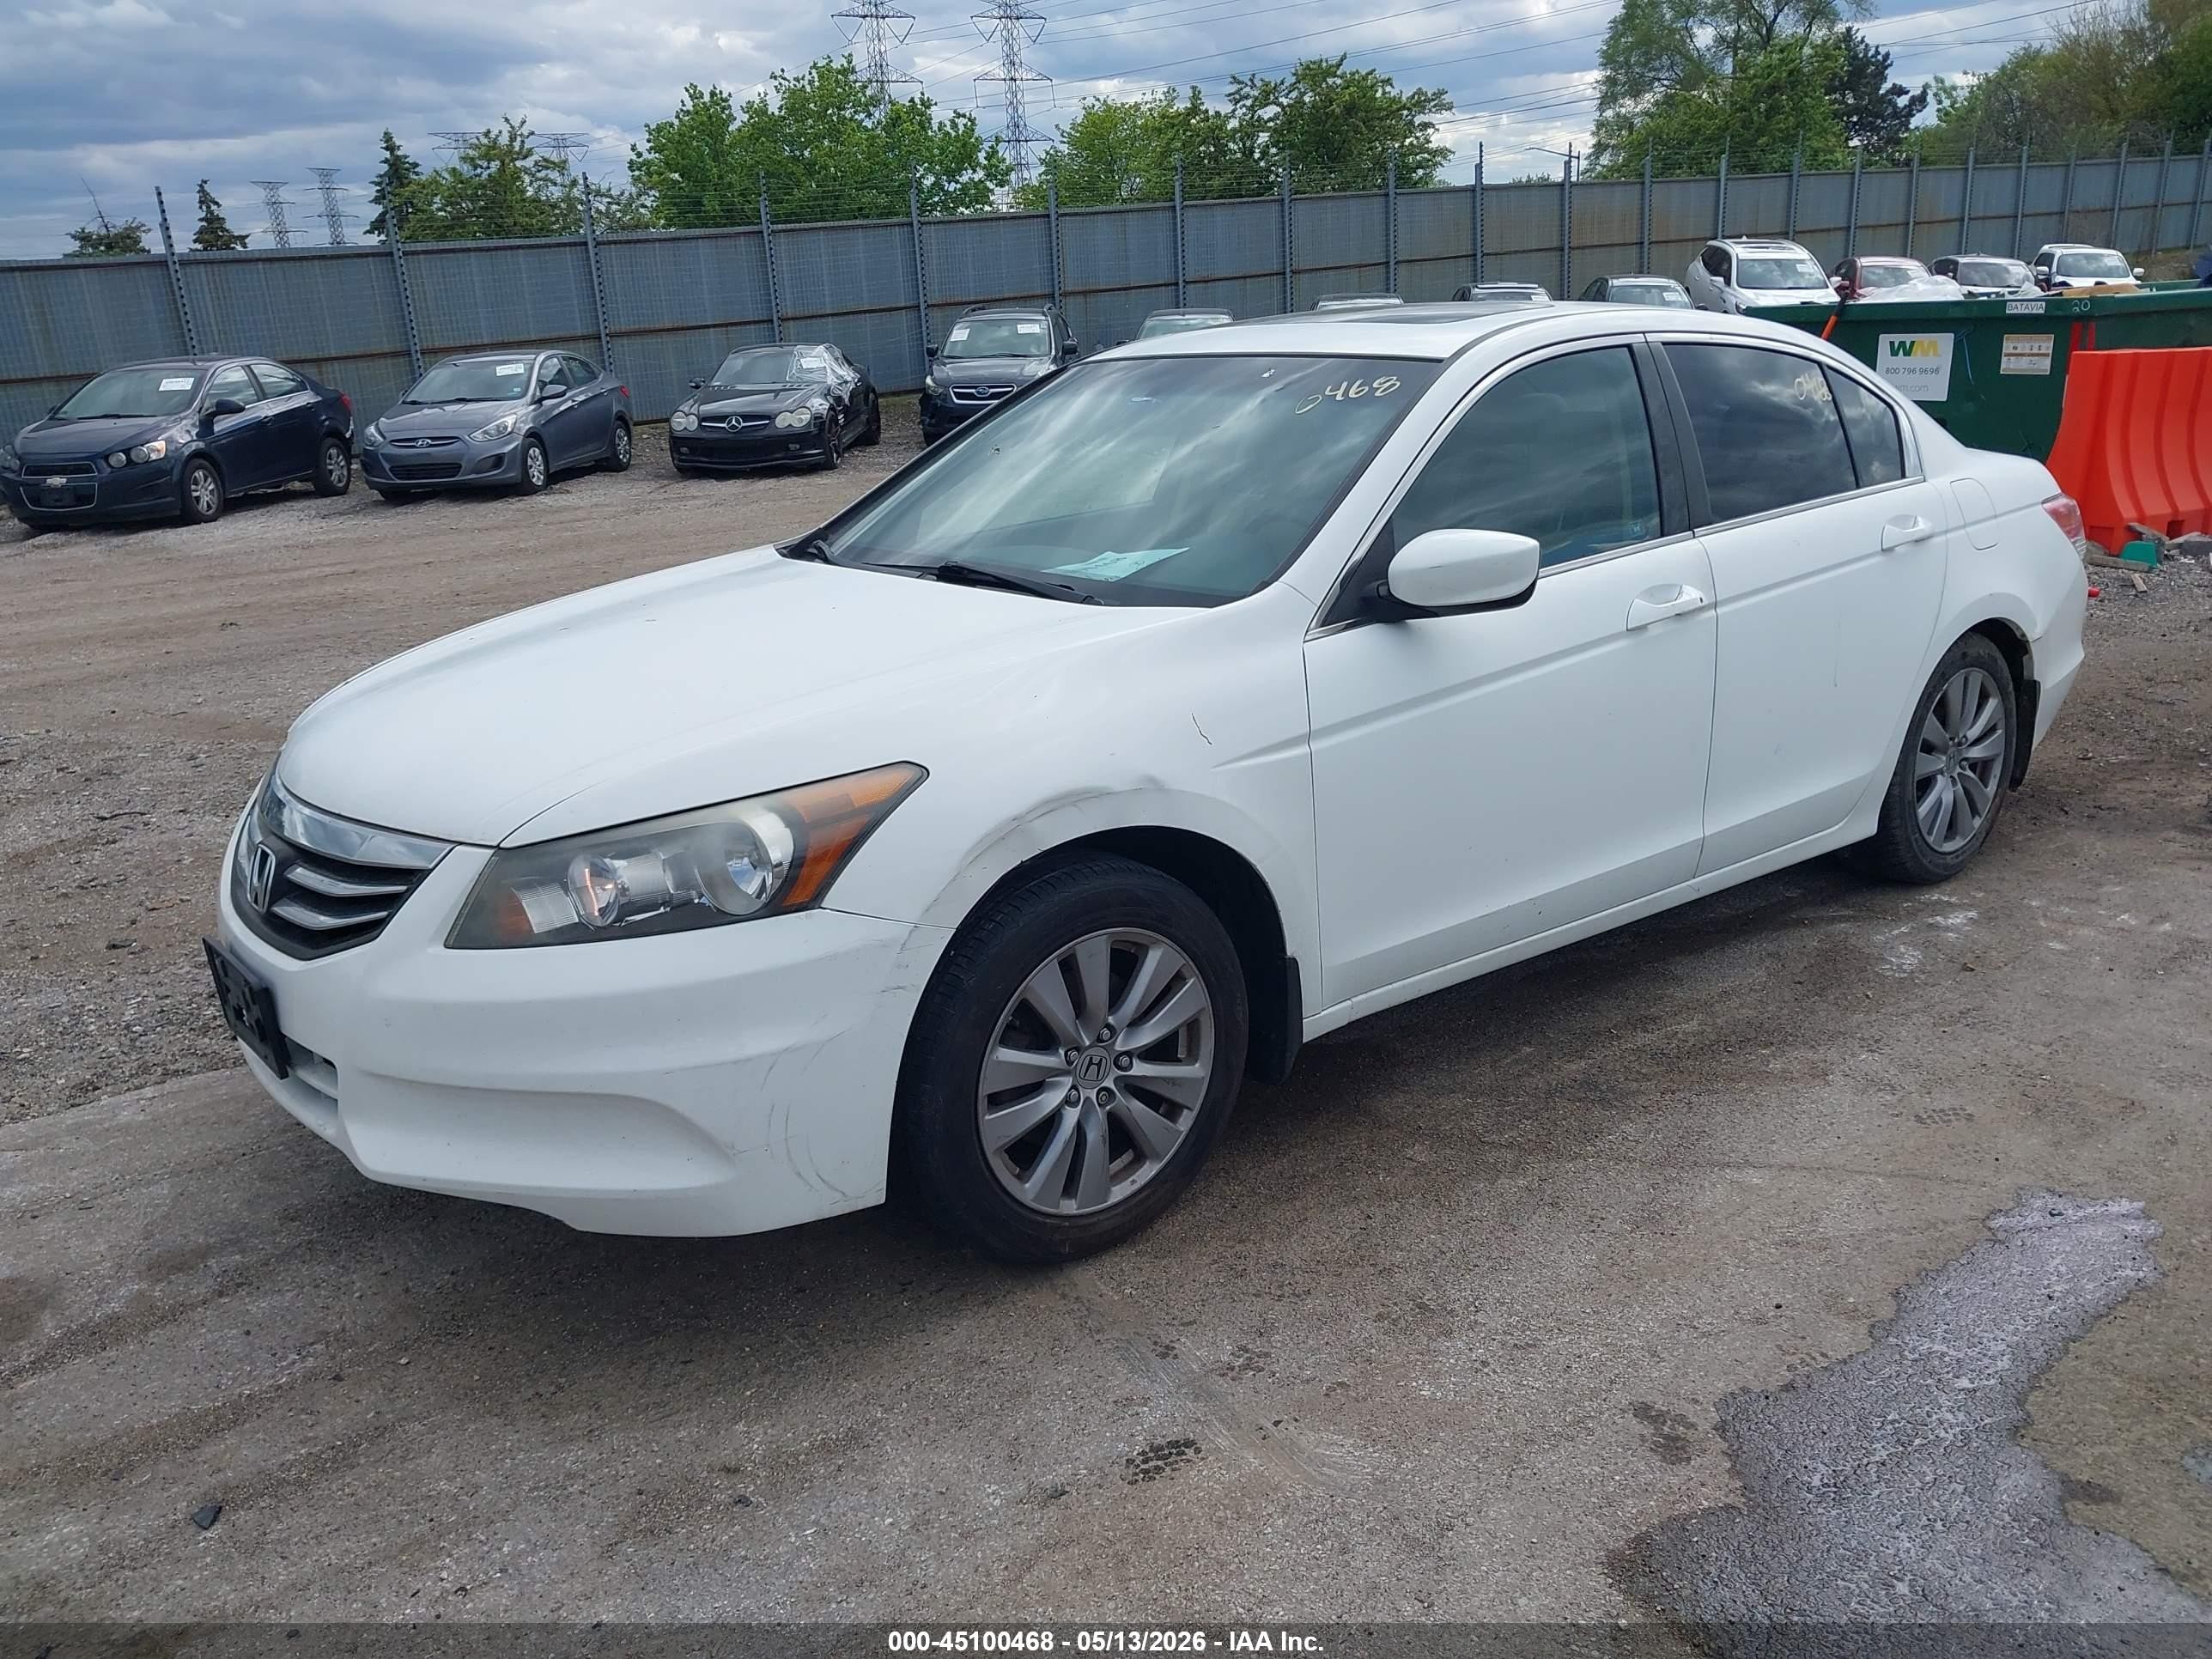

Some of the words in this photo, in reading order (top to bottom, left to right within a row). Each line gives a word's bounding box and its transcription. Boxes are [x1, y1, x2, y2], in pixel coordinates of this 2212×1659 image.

[2007, 302, 2044, 312] BATAVIA
[2071, 299, 2091, 313] 20
[1889, 340, 1938, 357] WM
[1902, 367, 1917, 375] 796
[1295, 376, 1401, 414] 0468
